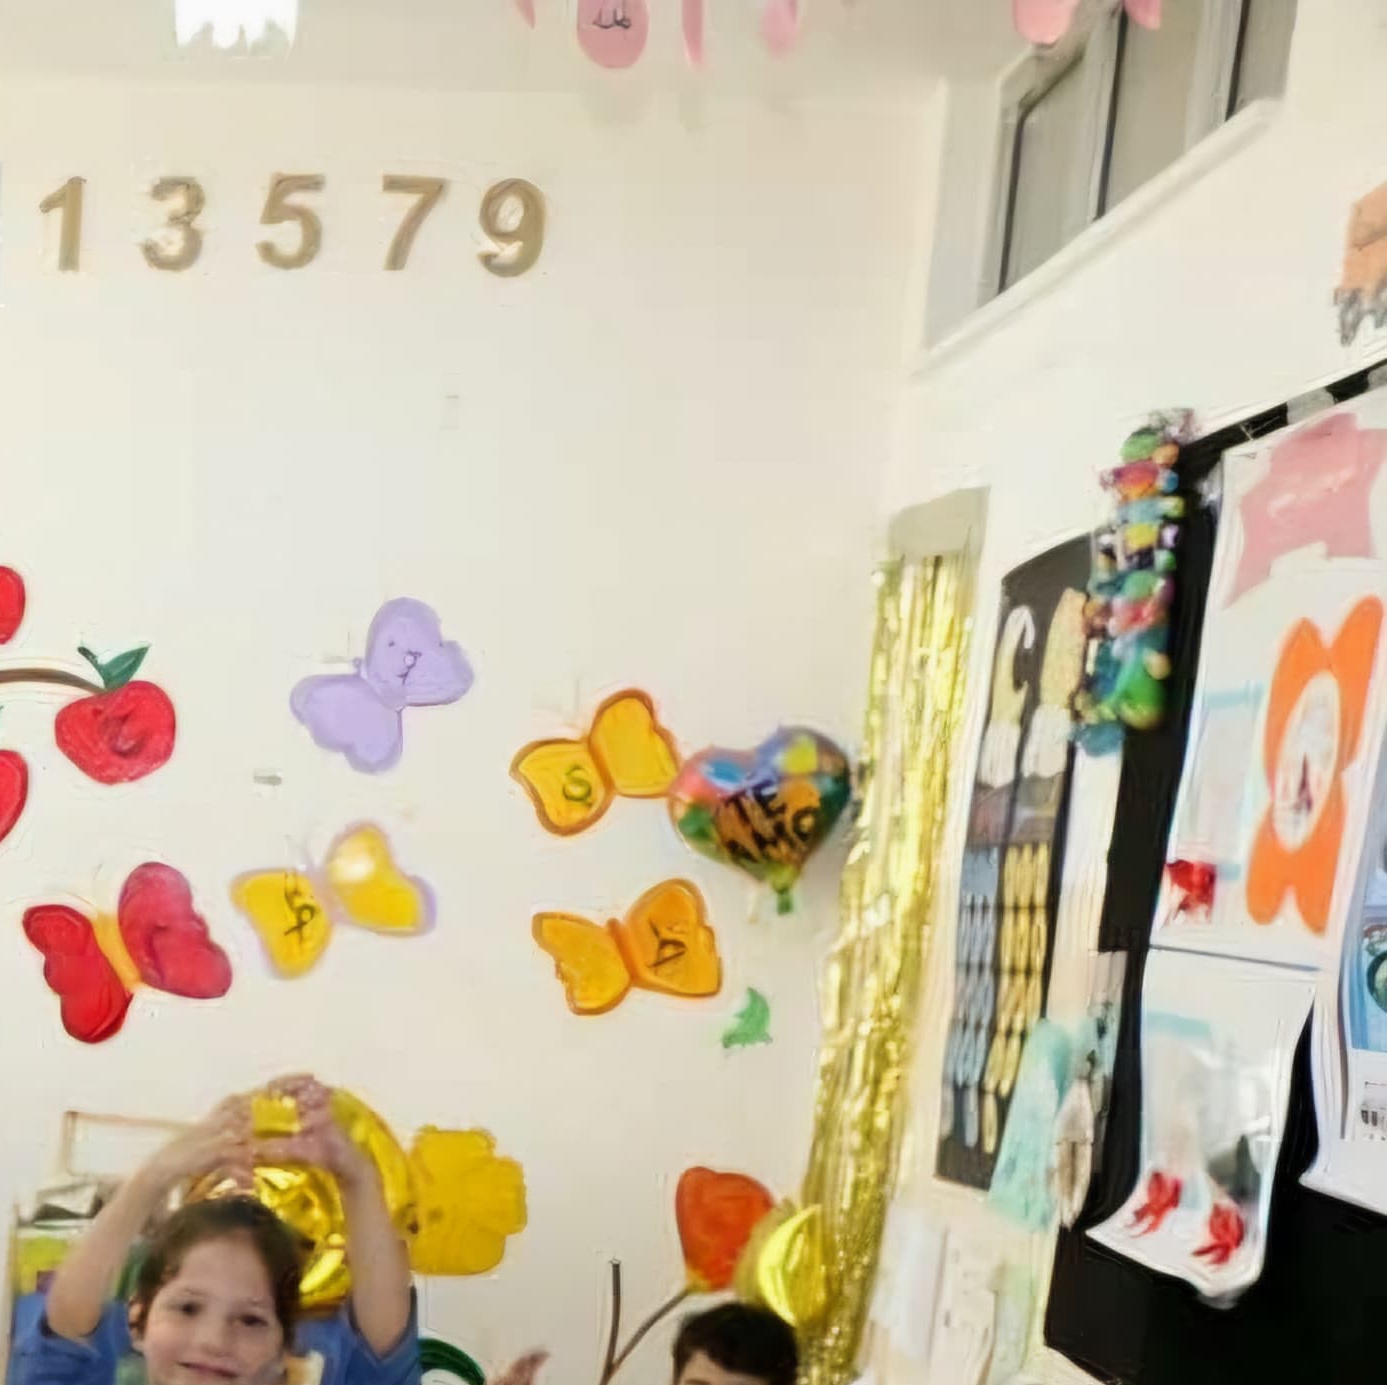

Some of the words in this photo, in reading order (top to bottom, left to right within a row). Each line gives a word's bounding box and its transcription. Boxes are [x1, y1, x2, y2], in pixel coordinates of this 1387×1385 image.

[39, 176, 86, 271] 1
[141, 176, 207, 271] 3
[255, 173, 325, 271] 5
[382, 173, 450, 271] 7
[478, 177, 547, 278] 9
